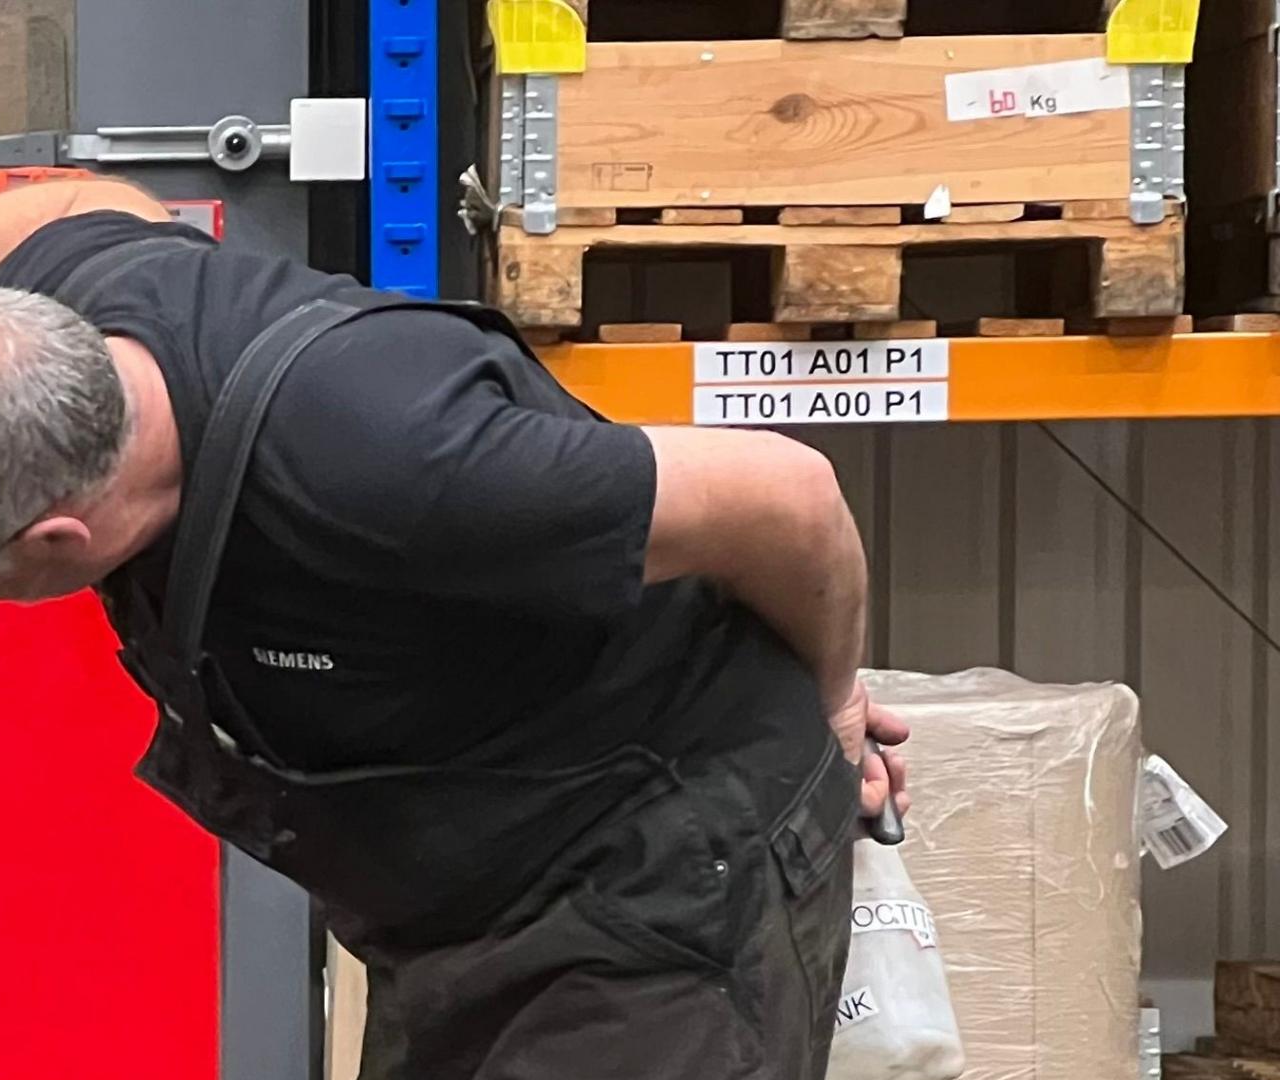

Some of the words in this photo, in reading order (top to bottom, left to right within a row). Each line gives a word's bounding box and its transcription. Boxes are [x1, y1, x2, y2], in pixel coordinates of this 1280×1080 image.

[1030, 95, 1057, 113] Kg
[715, 350, 793, 376] TT01
[808, 348, 869, 375] A01
[885, 348, 922, 373] P1
[714, 392, 792, 419] TT01
[807, 391, 871, 418] A00
[885, 390, 922, 416] P1
